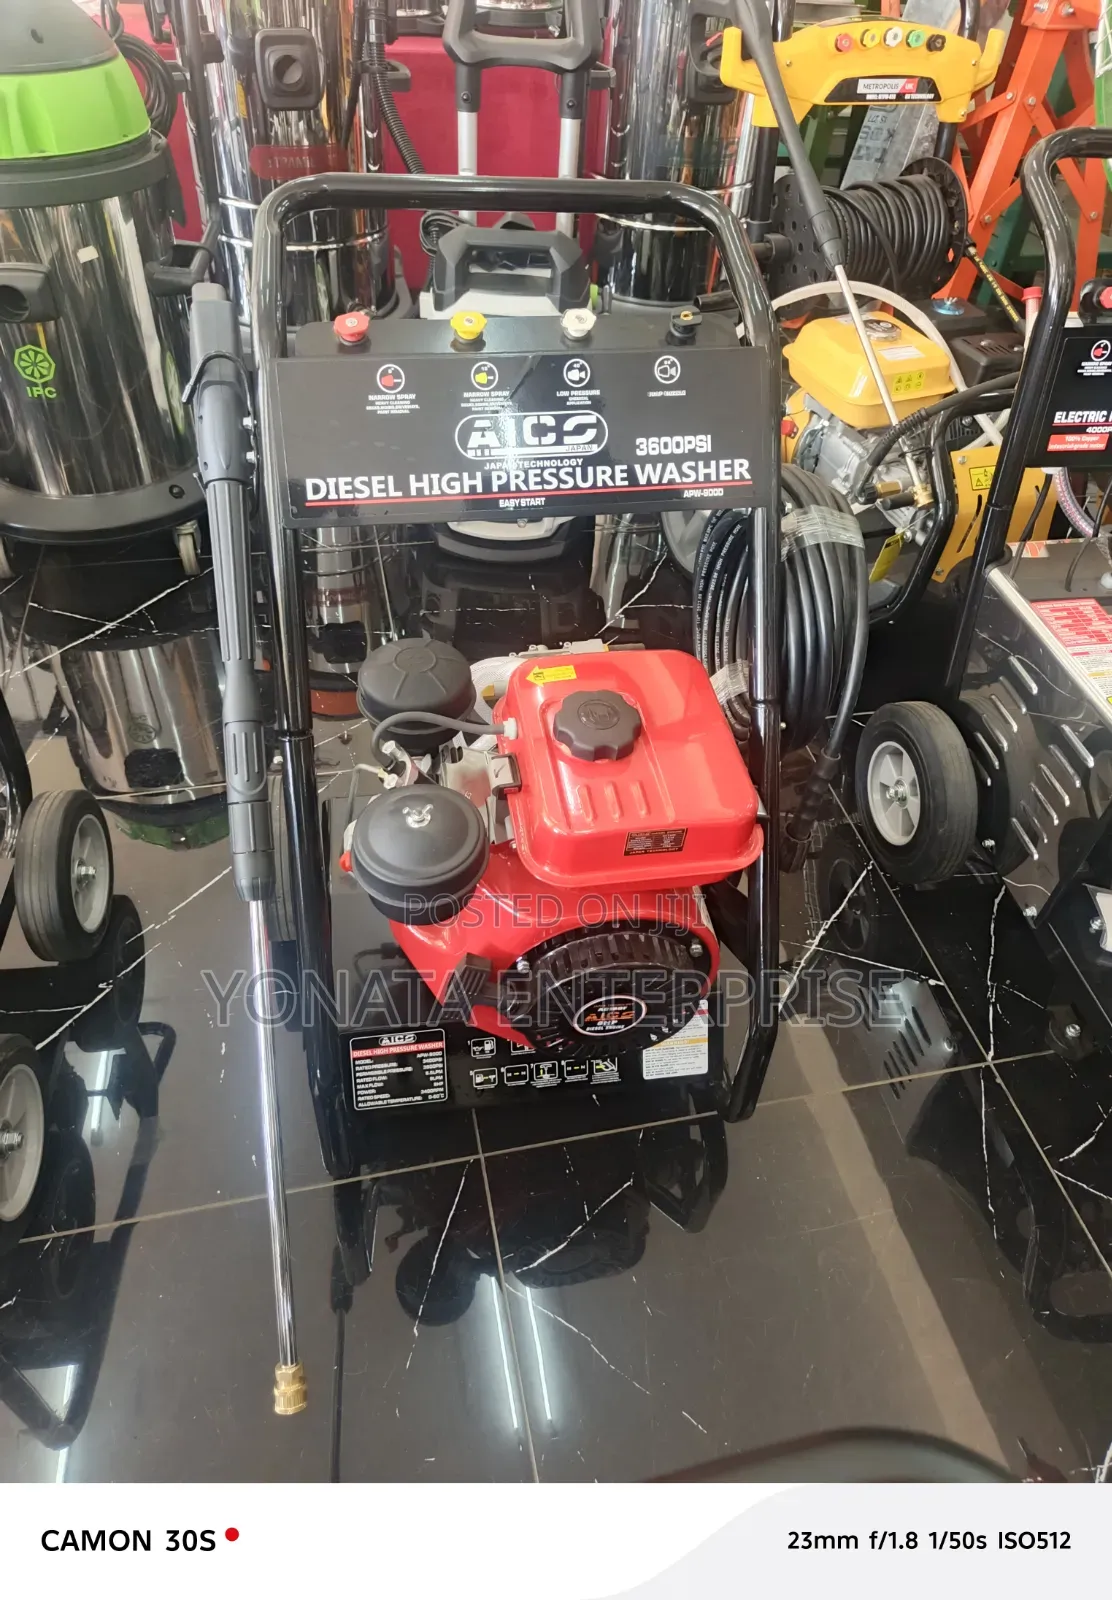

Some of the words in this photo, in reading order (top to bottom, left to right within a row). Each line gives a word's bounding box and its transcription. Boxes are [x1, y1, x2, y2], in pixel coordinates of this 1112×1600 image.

[26, 386, 57, 398] IPC
[1054, 411, 1107, 423] ELECTRIC
[636, 435, 712, 456] 3600PSI
[518, 458, 583, 469] TECHNOLOGY
[305, 475, 403, 501] DIESEL
[410, 471, 483, 496] HIGH
[491, 465, 629, 492] PRESSURE
[634, 459, 751, 485] WASHER
[499, 499, 520, 508] EASY
[520, 497, 546, 506] START
[721, 534, 734, 556] PRESSURE
[733, 524, 742, 534] HOSE
[417, 1042, 443, 1050] WASHER
